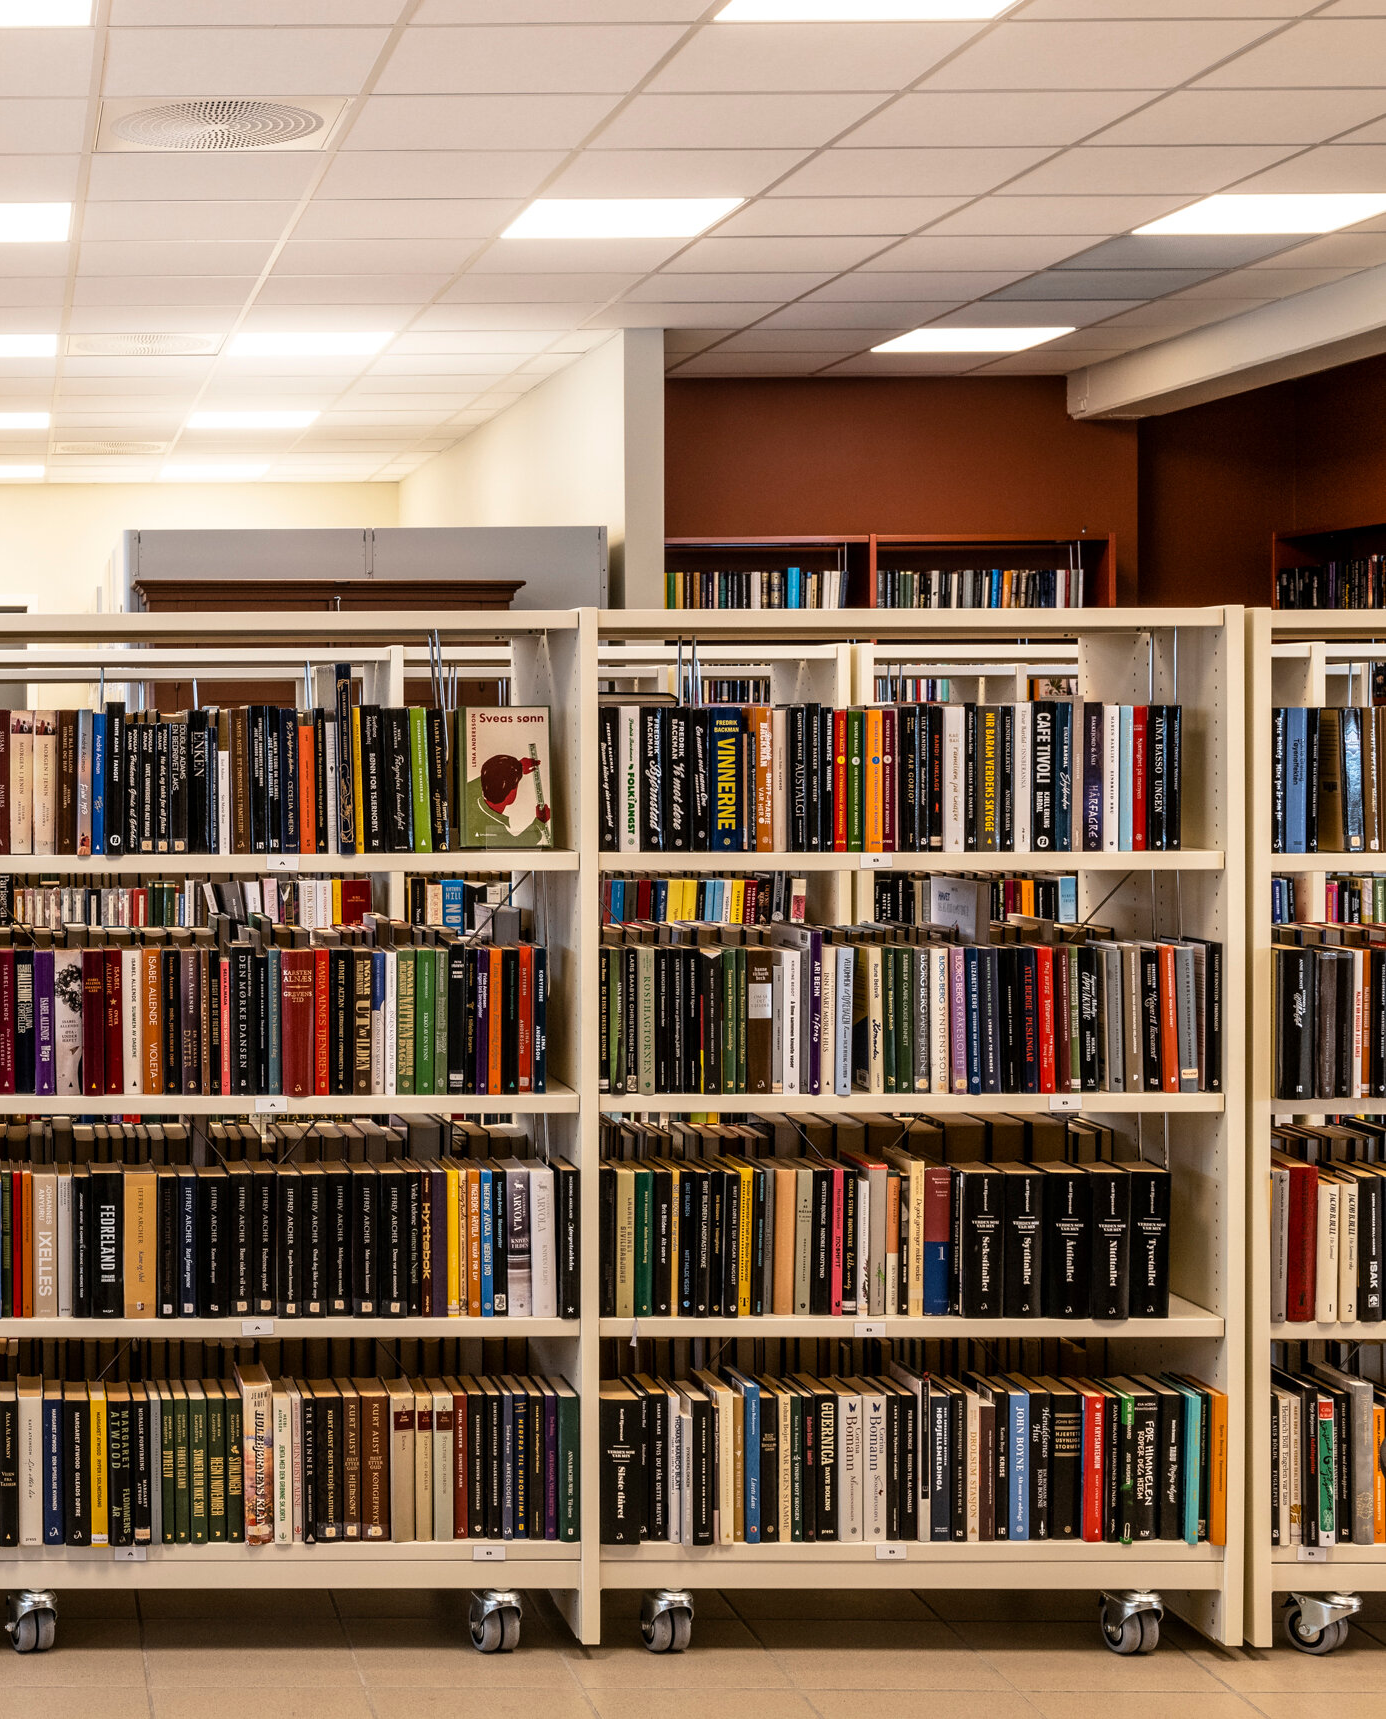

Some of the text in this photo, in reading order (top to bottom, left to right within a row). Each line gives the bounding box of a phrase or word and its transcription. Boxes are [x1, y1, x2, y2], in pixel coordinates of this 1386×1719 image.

[172, 725, 178, 733] EN
[479, 714, 513, 722] Sveas
[194, 731, 204, 777] ENKEN
[985, 713, 995, 831] NIR BARAM VERDENS SKYGGE
[1036, 713, 1050, 782] CAFE TIVOLI
[645, 761, 661, 831] Bjørnstad
[673, 763, 684, 830] Vi mot dere
[718, 738, 736, 830] VINNERNE
[1088, 785, 1099, 838] HÅRFAGRE
[318, 1028, 326, 1076] TJENEREN
[812, 1013, 820, 1042] Inferno
[39, 1232, 52, 1296] IXELLES
[100, 1205, 116, 1270] FEDRELAND
[422, 1203, 431, 1279] Hyttebok
[982, 1237, 990, 1292] Sekstitallet
[1022, 1238, 1031, 1285] Syttitallet
[1066, 1239, 1076, 1282] Åttitallet
[1147, 1239, 1157, 1286] Tyvetallet
[111, 1412, 120, 1468] ATWOOD
[253, 1410, 265, 1495] HULEBJØRNENS
[821, 1402, 834, 1465] GUERNICA
[870, 1416, 881, 1471] Bomann
[1016, 1407, 1024, 1471] JOHN BOYNE
[1032, 1424, 1042, 1442] Hus
[1042, 1408, 1050, 1458] Hendelsenes
[163, 1451, 173, 1478] DYRELIV
[229, 1457, 241, 1495] STIKLINGEN
[1145, 1421, 1154, 1506] FØR HIMMELEN
